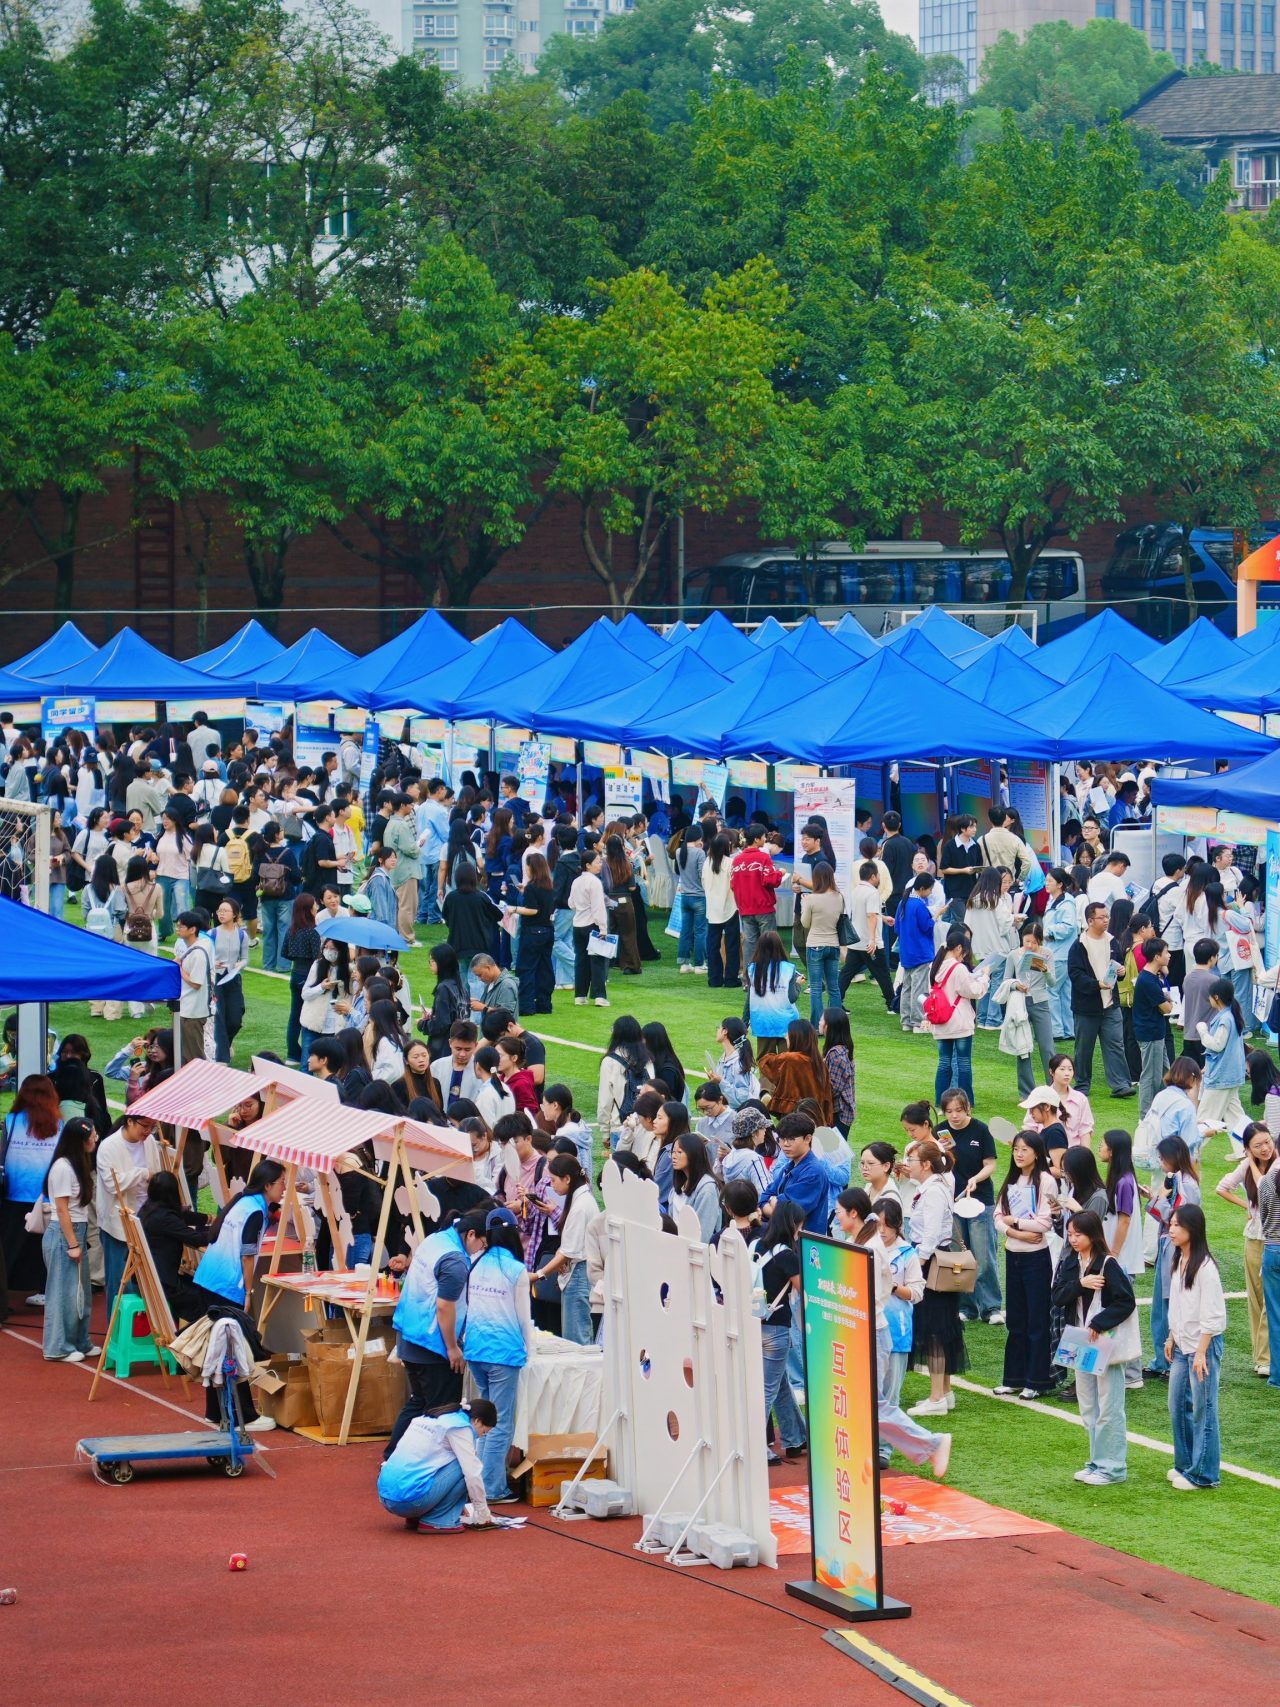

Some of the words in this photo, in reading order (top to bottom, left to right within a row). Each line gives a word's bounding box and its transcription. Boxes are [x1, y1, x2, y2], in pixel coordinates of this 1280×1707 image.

[832, 1342, 852, 1545] 互动体验区
